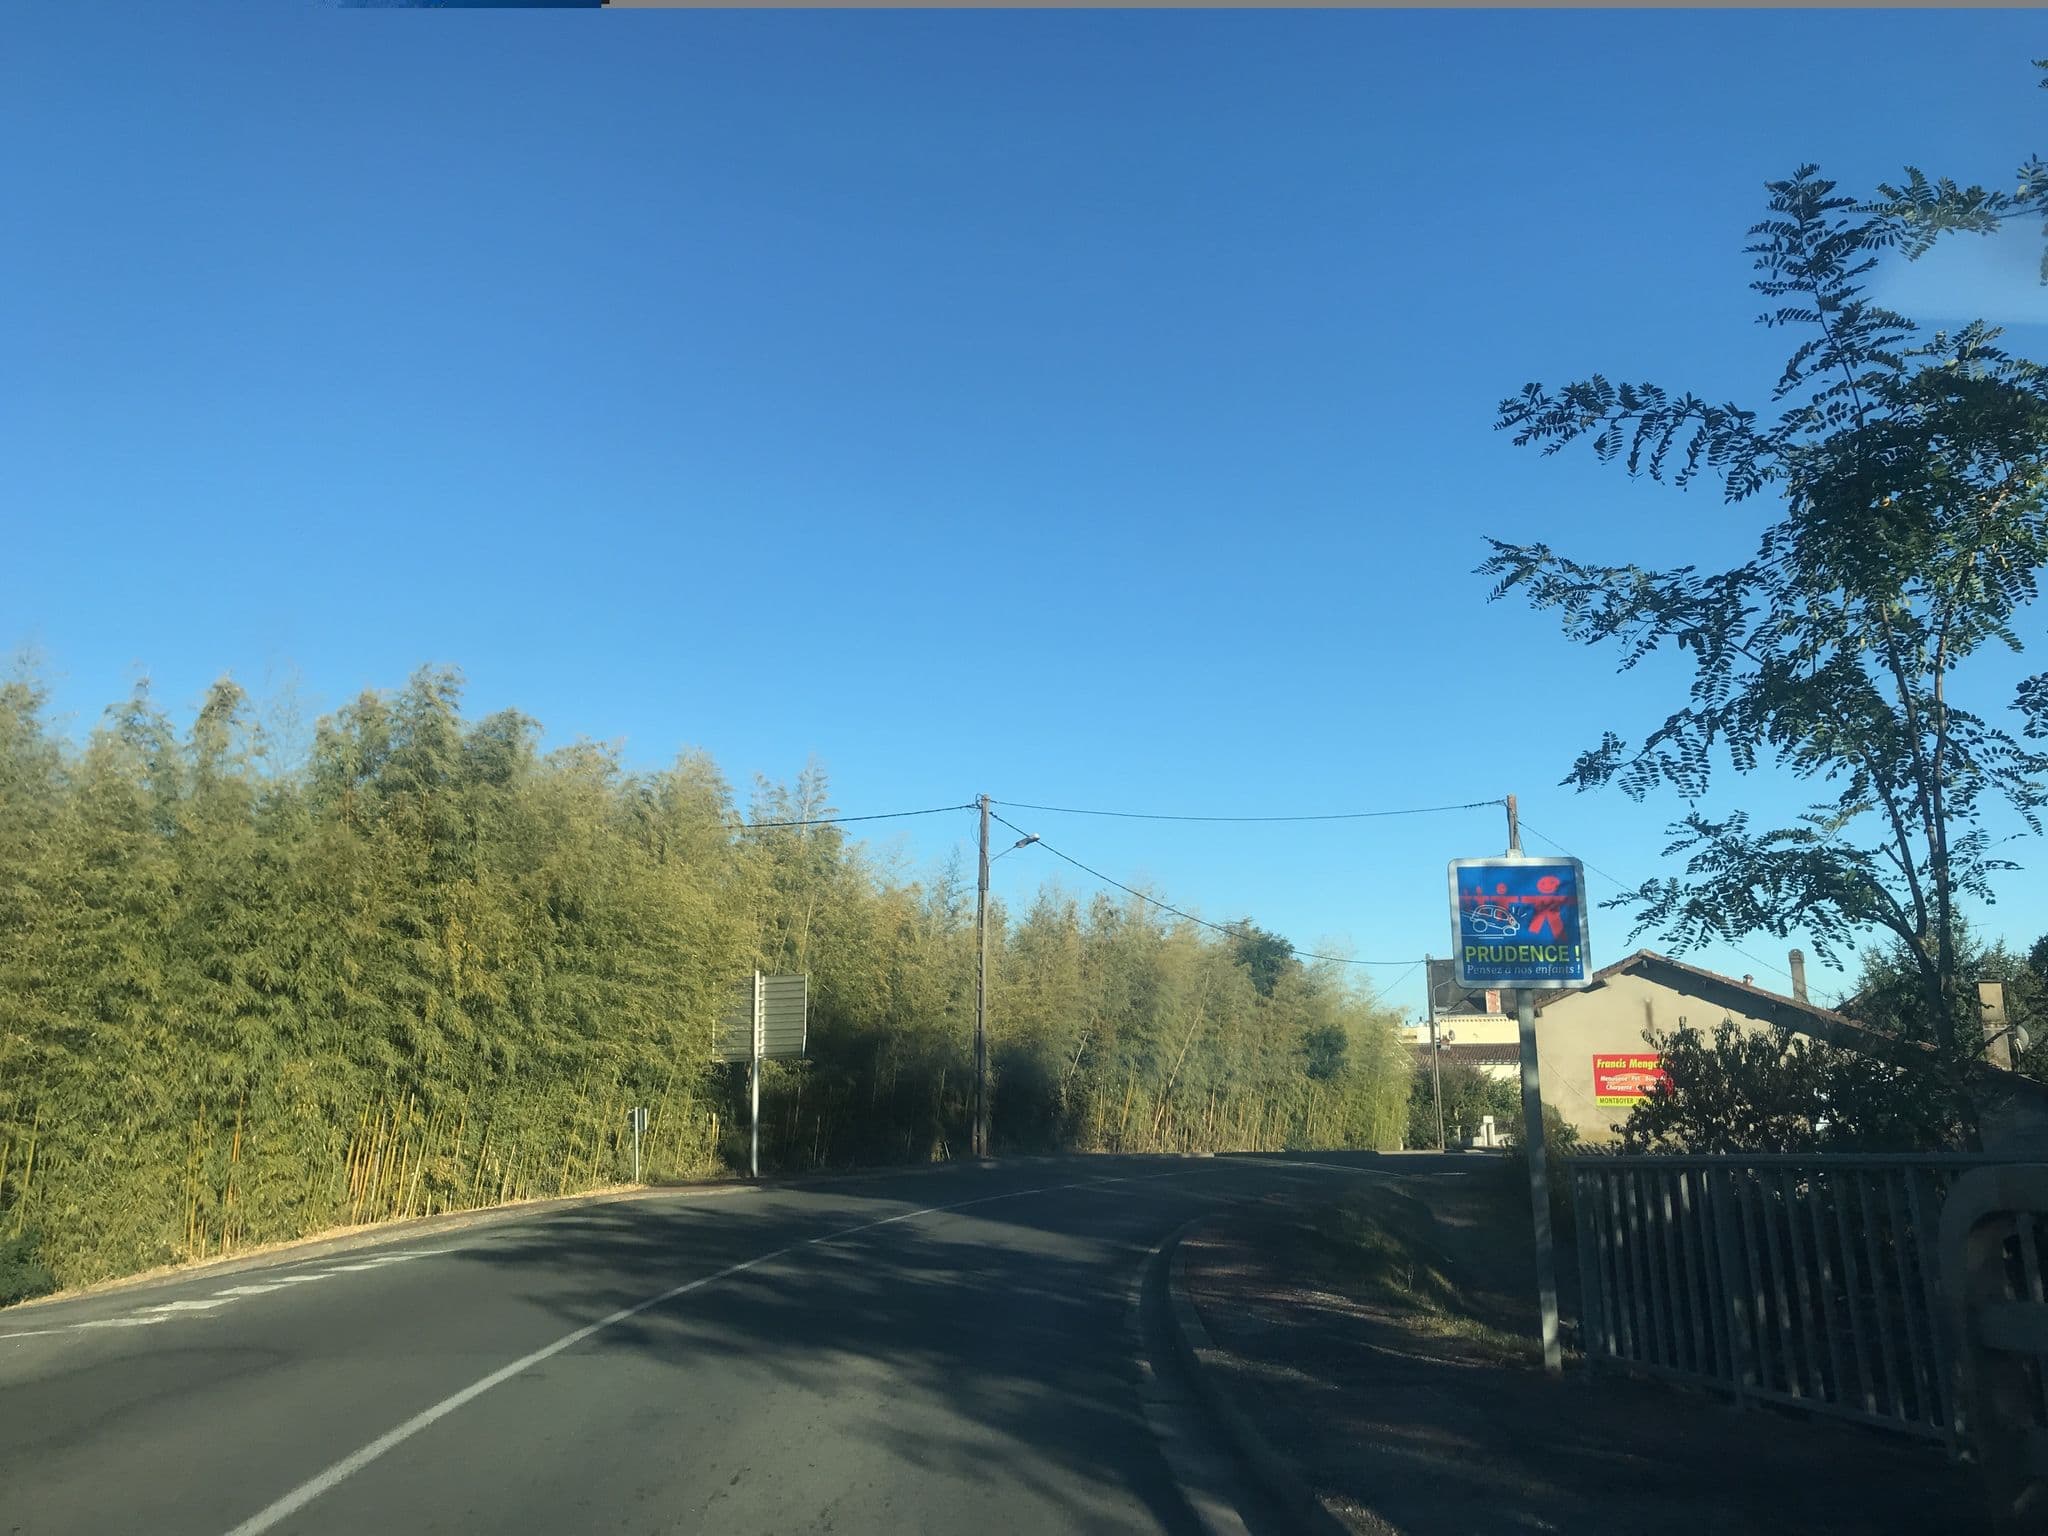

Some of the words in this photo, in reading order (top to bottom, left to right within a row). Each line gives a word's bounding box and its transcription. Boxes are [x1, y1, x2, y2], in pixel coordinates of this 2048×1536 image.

[1465, 946, 1570, 962] PRUDENCE
[1467, 965, 1503, 974] Pensez
[1514, 966, 1533, 974] nos
[1535, 964, 1575, 975] enfants
[1597, 1058, 1626, 1069] Francis
